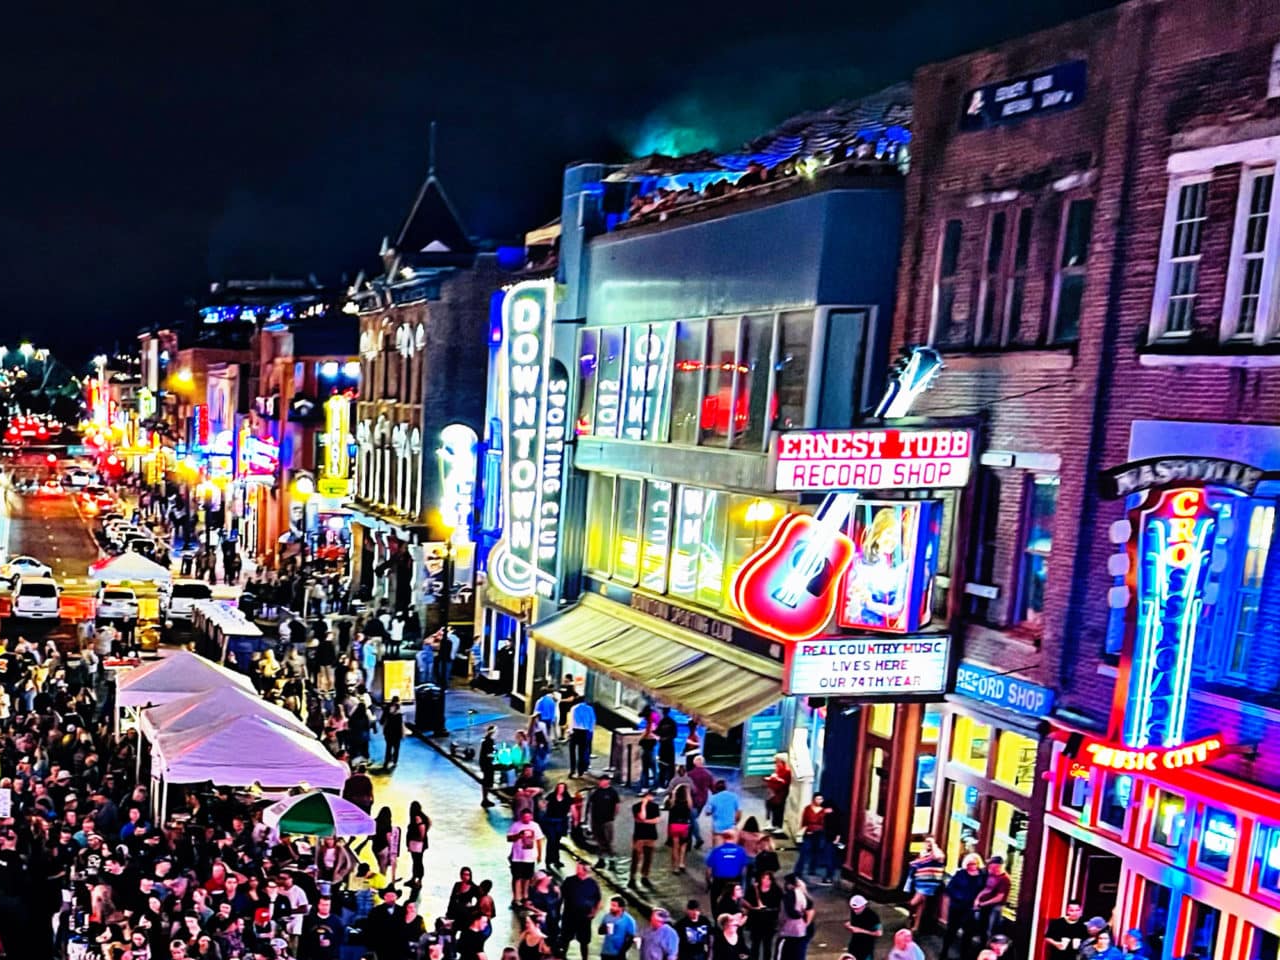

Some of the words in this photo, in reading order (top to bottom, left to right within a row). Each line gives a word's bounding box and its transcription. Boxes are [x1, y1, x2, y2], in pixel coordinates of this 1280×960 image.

[510, 298, 542, 548] DOWNTOWN
[542, 378, 567, 492] SPORTING
[780, 431, 886, 459] ERNEST
[898, 430, 969, 458] TUBB
[793, 463, 883, 487] RECORD
[893, 462, 952, 485] SHOP
[1116, 459, 1261, 496] NASHVILLE
[537, 501, 560, 559] CLUB
[802, 644, 836, 656] REAL
[839, 643, 903, 655] COUNTRY
[904, 642, 942, 654] MUSIC
[832, 660, 870, 672] LIVES
[874, 659, 909, 671] HERE
[819, 676, 846, 688] OUR
[886, 675, 922, 687] YEAR
[956, 667, 1005, 700] RECORD
[1007, 685, 1045, 713] SHOP
